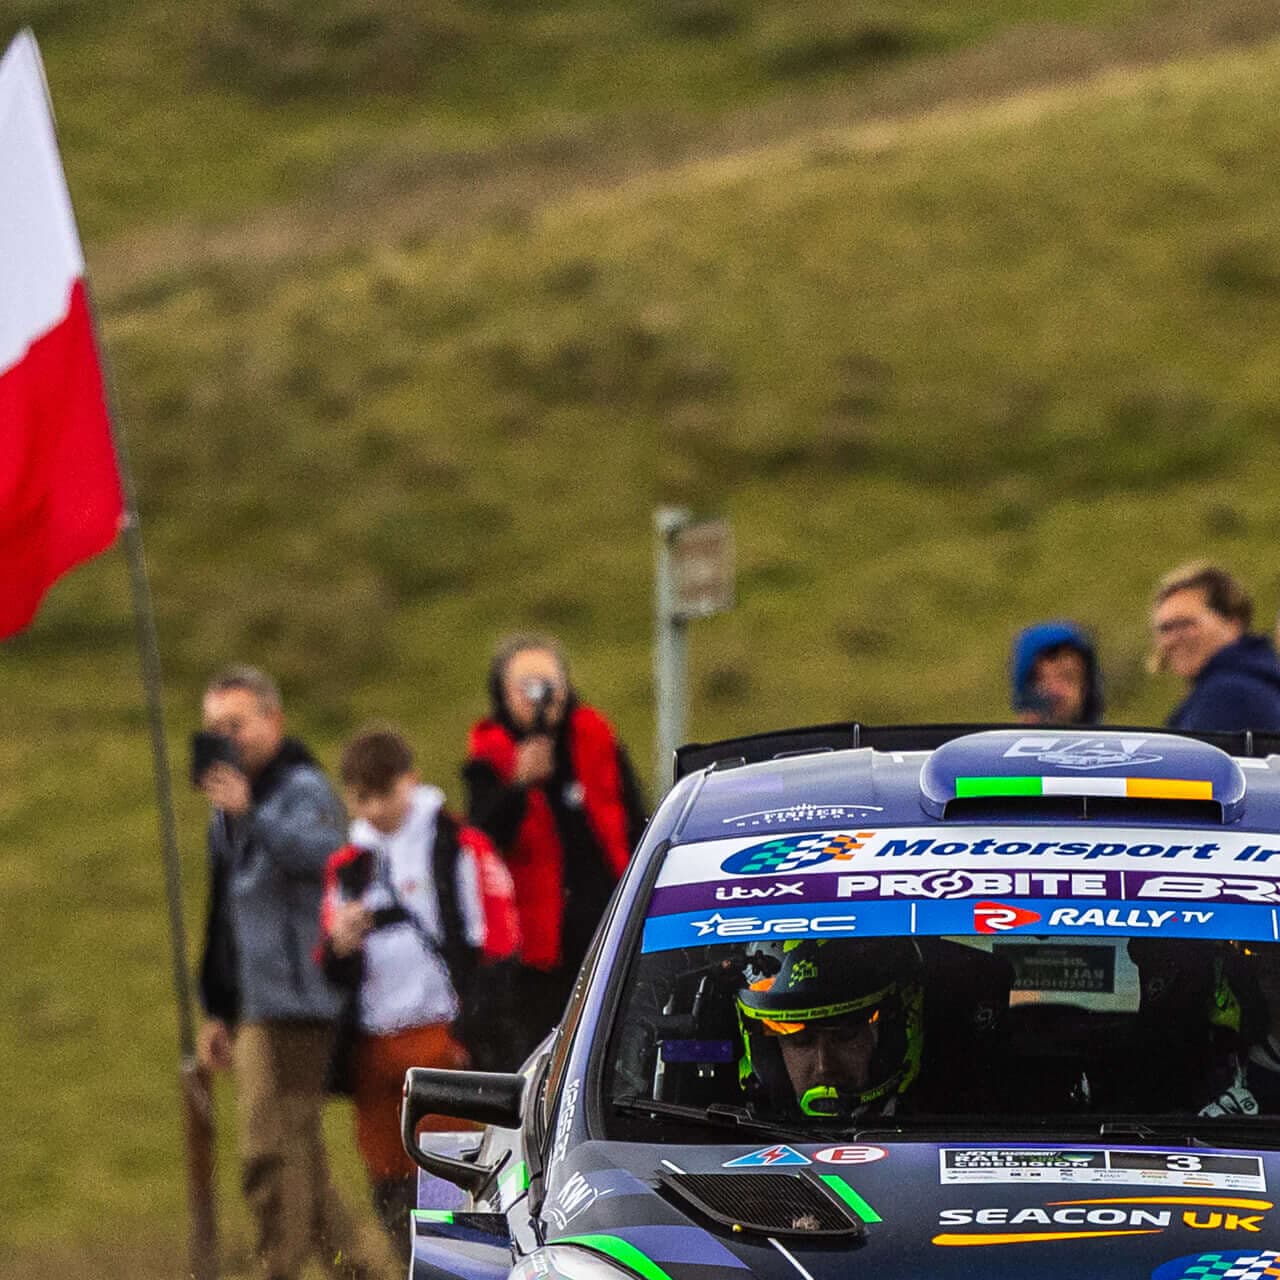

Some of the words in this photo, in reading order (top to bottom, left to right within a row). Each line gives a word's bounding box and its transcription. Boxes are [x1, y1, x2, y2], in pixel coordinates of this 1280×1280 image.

[874, 838, 1221, 860] Motorsport
[837, 870, 1107, 899] PROBITE
[716, 914, 856, 936] ERC
[831, 1149, 870, 1161] E
[1166, 1154, 1203, 1171] 3
[939, 1207, 1171, 1227] SEACON
[1182, 1211, 1265, 1232] UK
